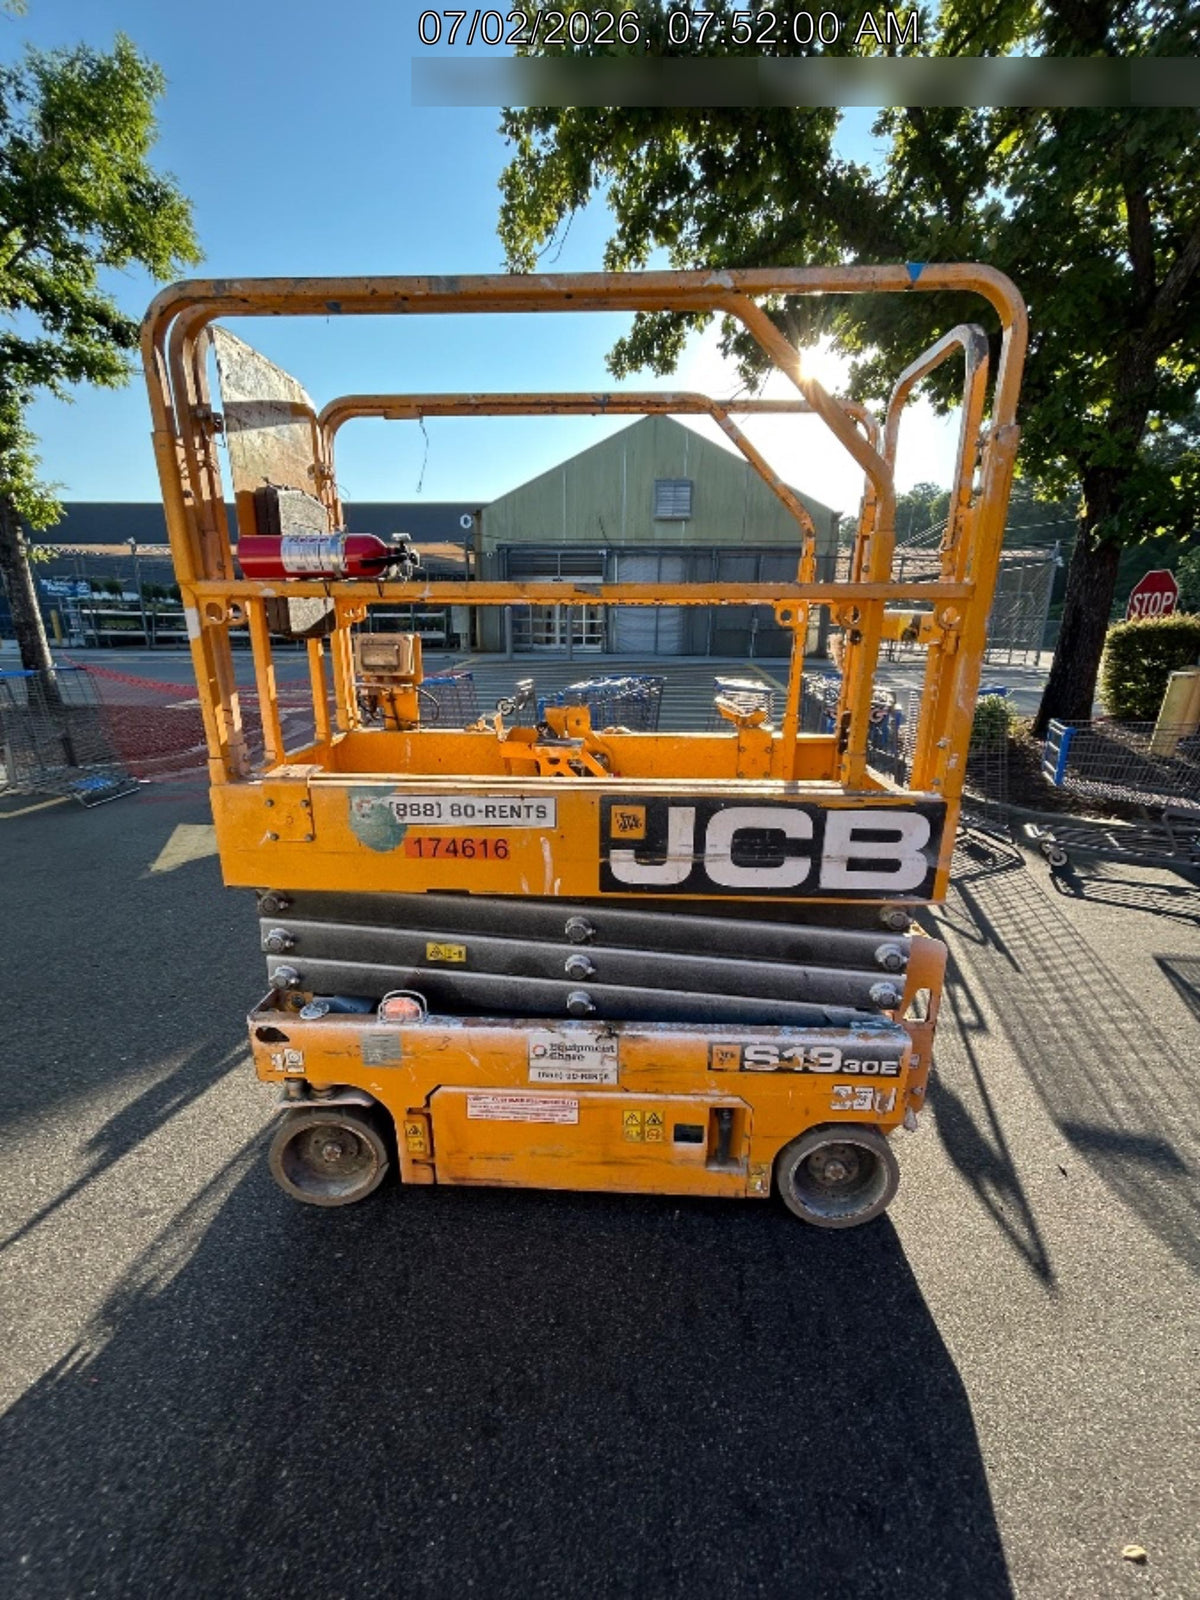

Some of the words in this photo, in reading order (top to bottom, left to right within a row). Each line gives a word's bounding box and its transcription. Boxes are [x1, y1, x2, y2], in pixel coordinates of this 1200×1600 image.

[1133, 592, 1174, 616] STOP
[450, 803, 547, 819] 80-RENTS
[414, 837, 509, 859] 174616
[610, 806, 932, 890] JCB
